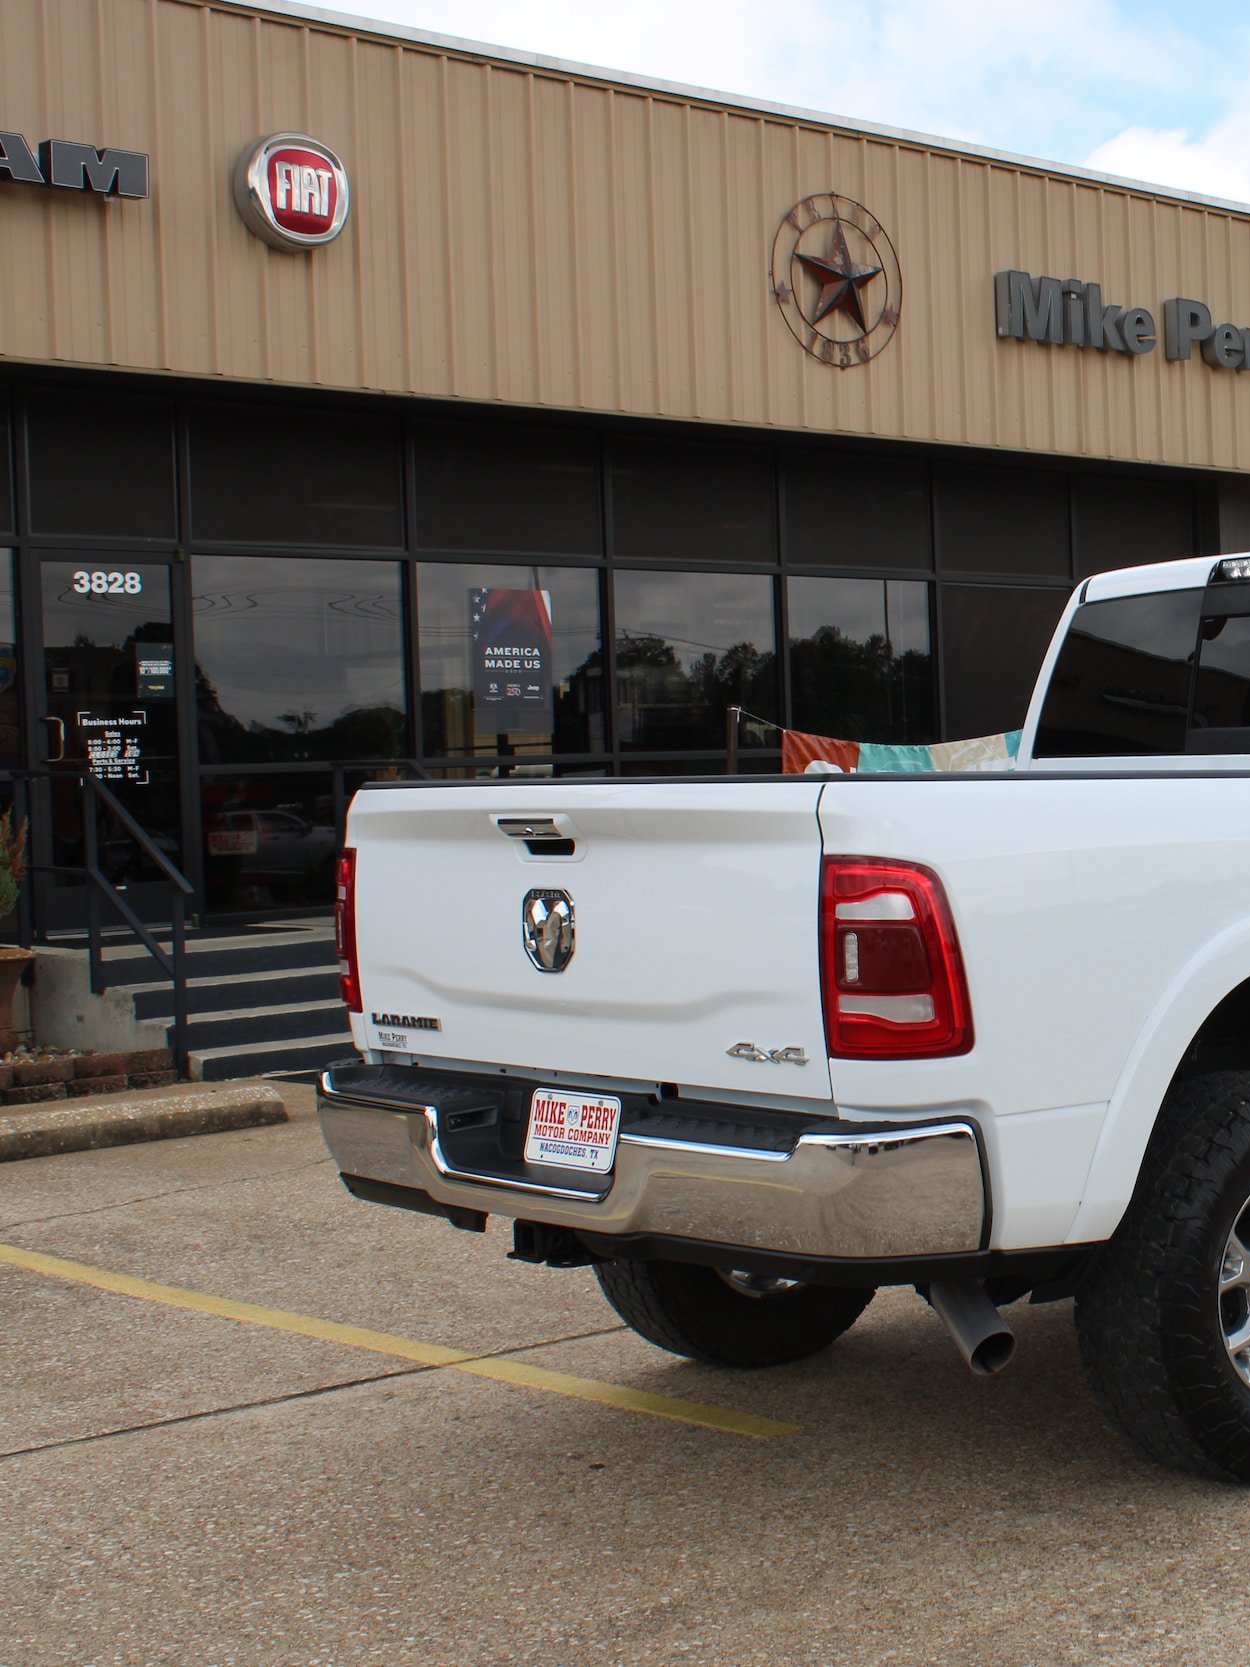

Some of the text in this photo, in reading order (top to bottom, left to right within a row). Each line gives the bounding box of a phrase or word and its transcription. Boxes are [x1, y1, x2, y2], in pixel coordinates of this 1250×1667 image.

[275, 160, 332, 217] FIAT
[994, 269, 1157, 356] Mike
[73, 571, 142, 594] 3828
[485, 647, 541, 657] AMERICA
[485, 660, 541, 669] MADE US
[82, 718, 142, 726] Business Hours
[371, 1012, 443, 1031] LARAMIE
[534, 1099, 617, 1132] MIKE PERRY
[534, 1124, 610, 1145] MOTOR COMPANY
[590, 1149, 599, 1159] TX
